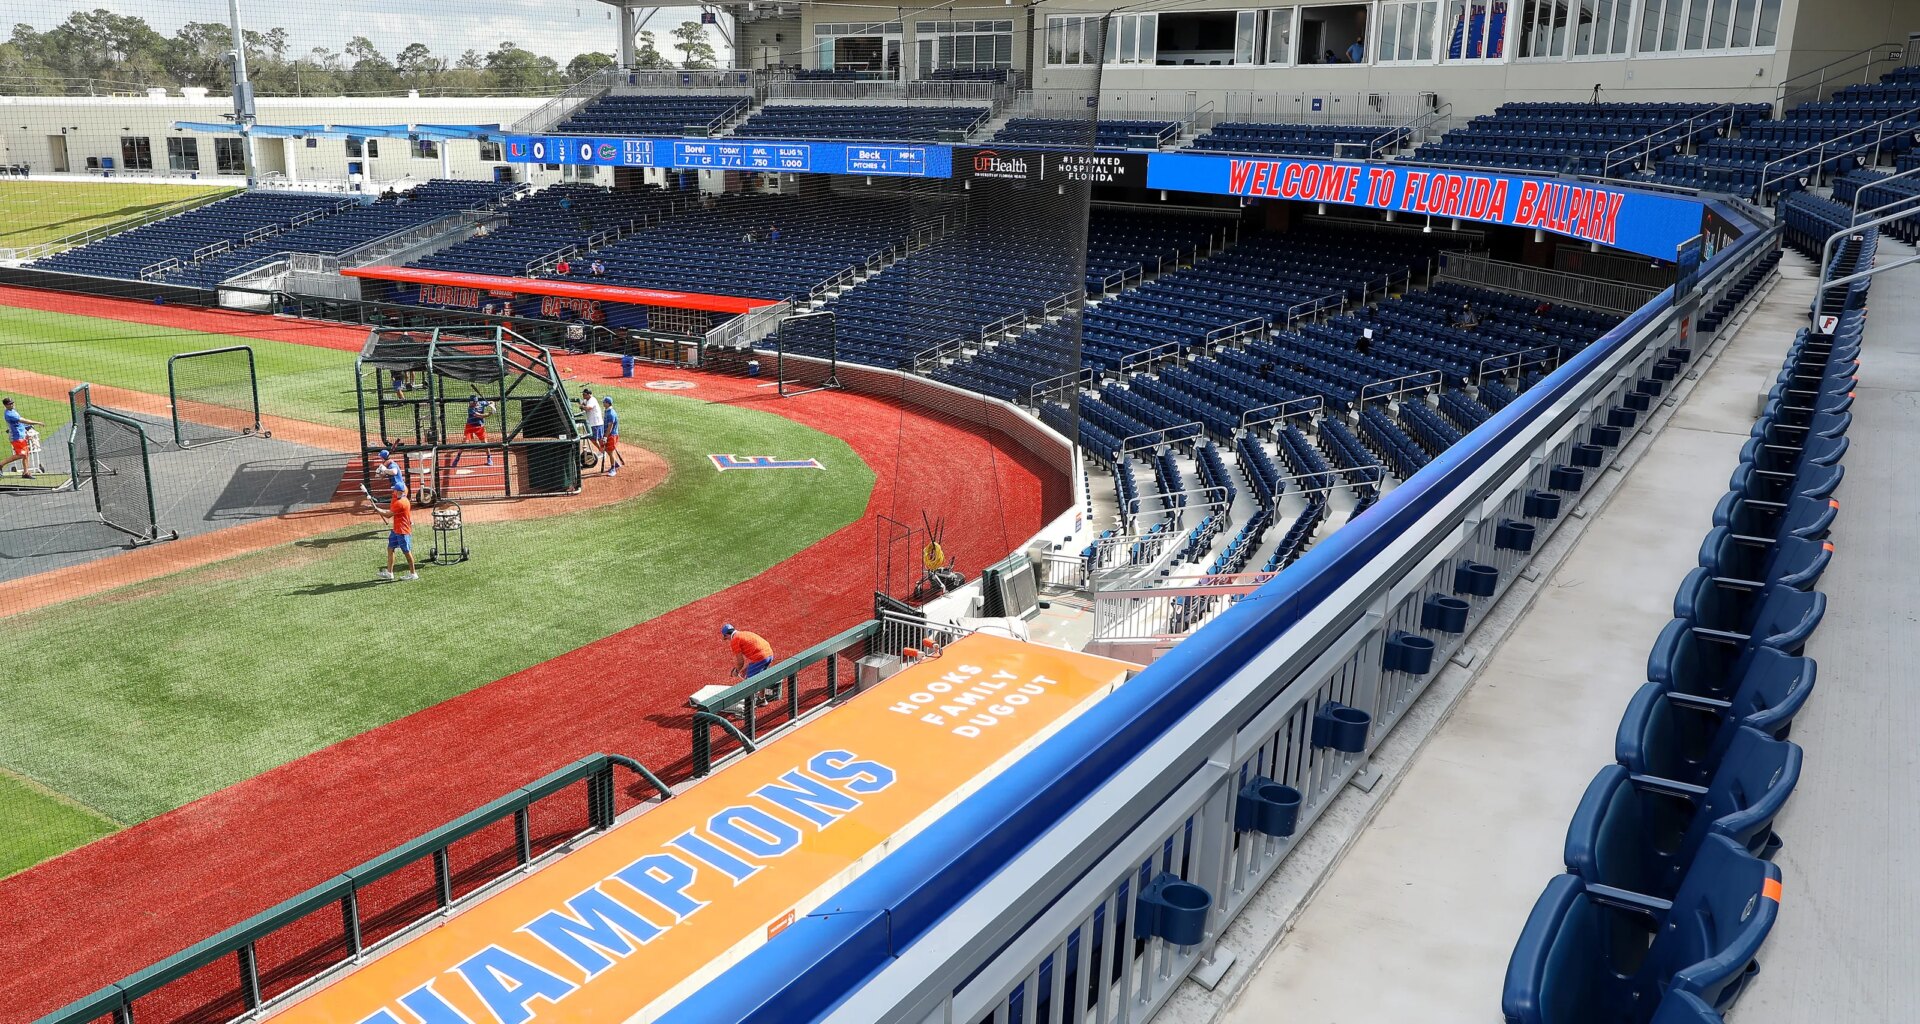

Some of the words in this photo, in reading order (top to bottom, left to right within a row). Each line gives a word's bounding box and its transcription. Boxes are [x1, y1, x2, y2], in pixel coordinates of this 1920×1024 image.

[533, 142, 545, 159] 0
[560, 147, 565, 156] 3
[581, 143, 592, 161] 0
[719, 147, 740, 155] TODAY
[859, 150, 881, 159] Beck
[626, 155, 632, 163] 3
[635, 155, 641, 163] 2
[644, 155, 650, 163] 1
[1062, 156, 1073, 164] #1
[1079, 156, 1121, 165] RANKED
[1058, 164, 1109, 174] HOSPITAL
[1114, 166, 1125, 174] IN
[1068, 172, 1113, 182] FLORIDA
[1229, 159, 1360, 204] WELCOME
[1365, 168, 1396, 207] TO
[1400, 171, 1508, 223] FLORIDA
[1512, 180, 1625, 245] BALLPARK
[419, 284, 479, 308] FLORIDA
[1823, 317, 1835, 329] F
[888, 664, 983, 714] HOOKS
[921, 669, 1018, 726] FAMILY
[952, 675, 1057, 738] DUGOUT
